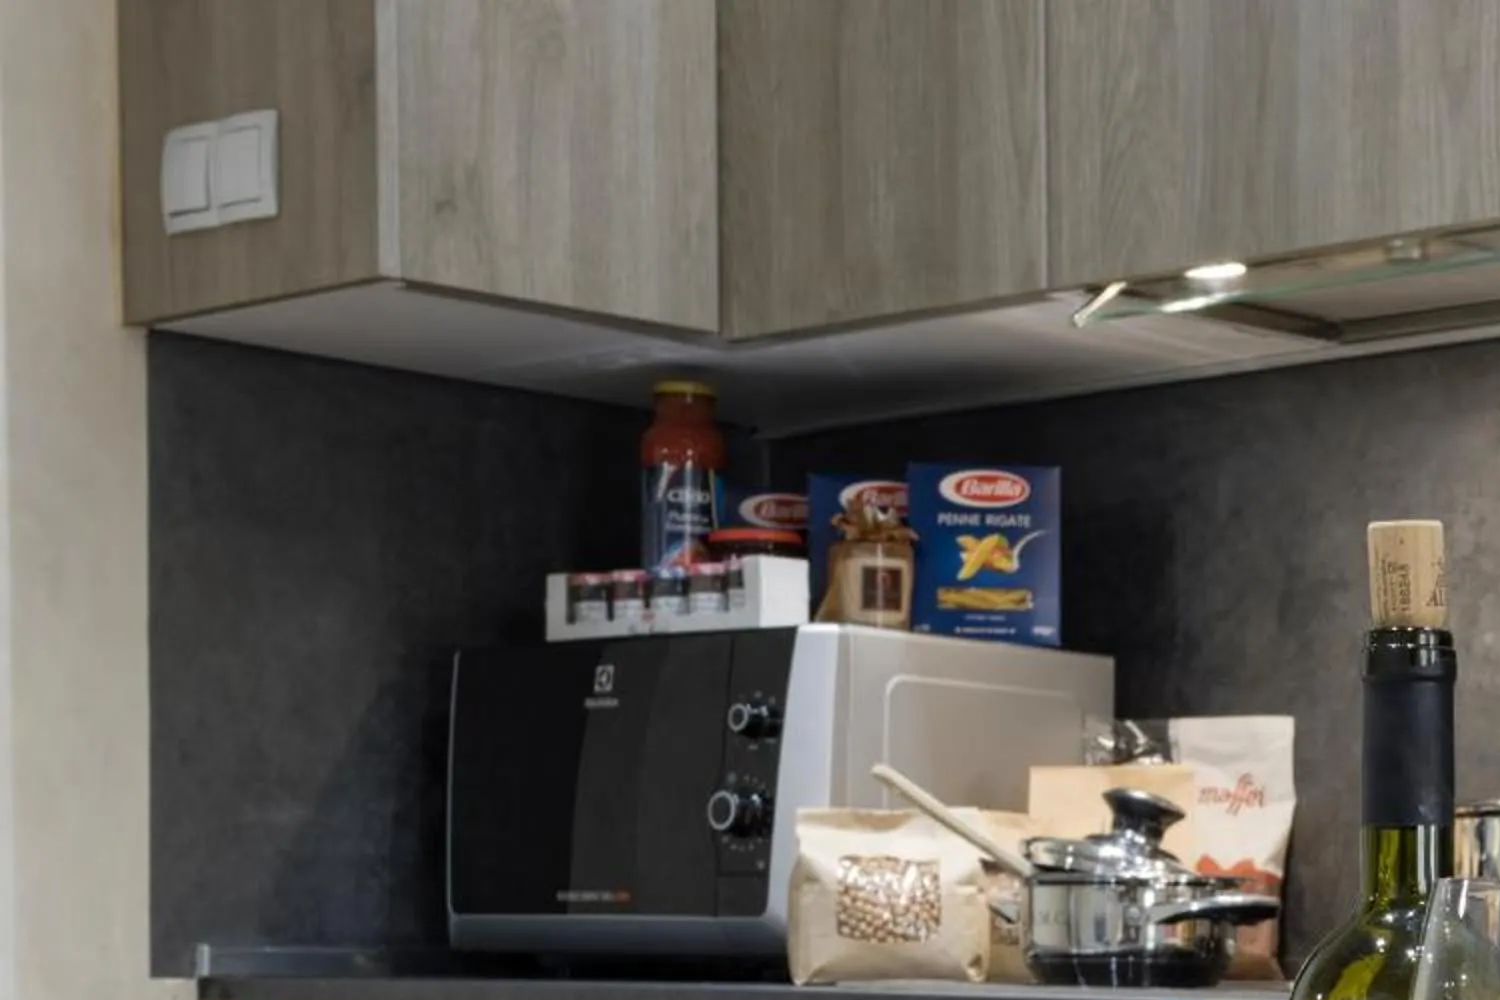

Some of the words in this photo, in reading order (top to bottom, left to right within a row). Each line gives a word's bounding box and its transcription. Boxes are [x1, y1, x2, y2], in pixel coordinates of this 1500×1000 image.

[961, 479, 1022, 497] Barilla
[937, 512, 981, 527] PENNE
[985, 513, 1031, 528] RIGATE
